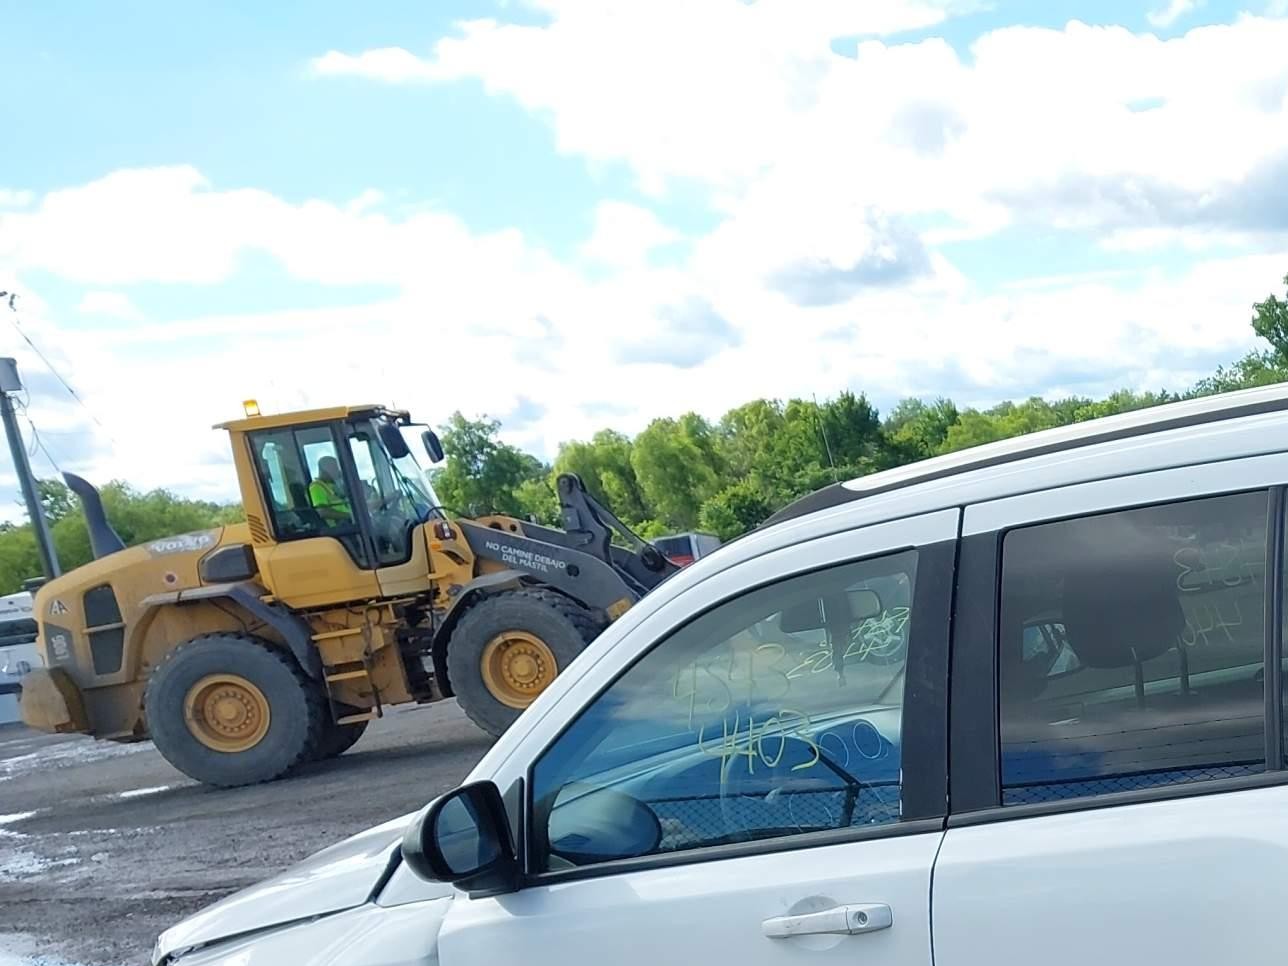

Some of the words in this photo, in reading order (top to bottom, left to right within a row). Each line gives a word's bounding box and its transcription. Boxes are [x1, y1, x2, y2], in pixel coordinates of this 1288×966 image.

[485, 541, 500, 551] NO
[501, 545, 534, 561] CAMINE
[534, 553, 566, 569] DEBAJO
[502, 553, 518, 564] DEL
